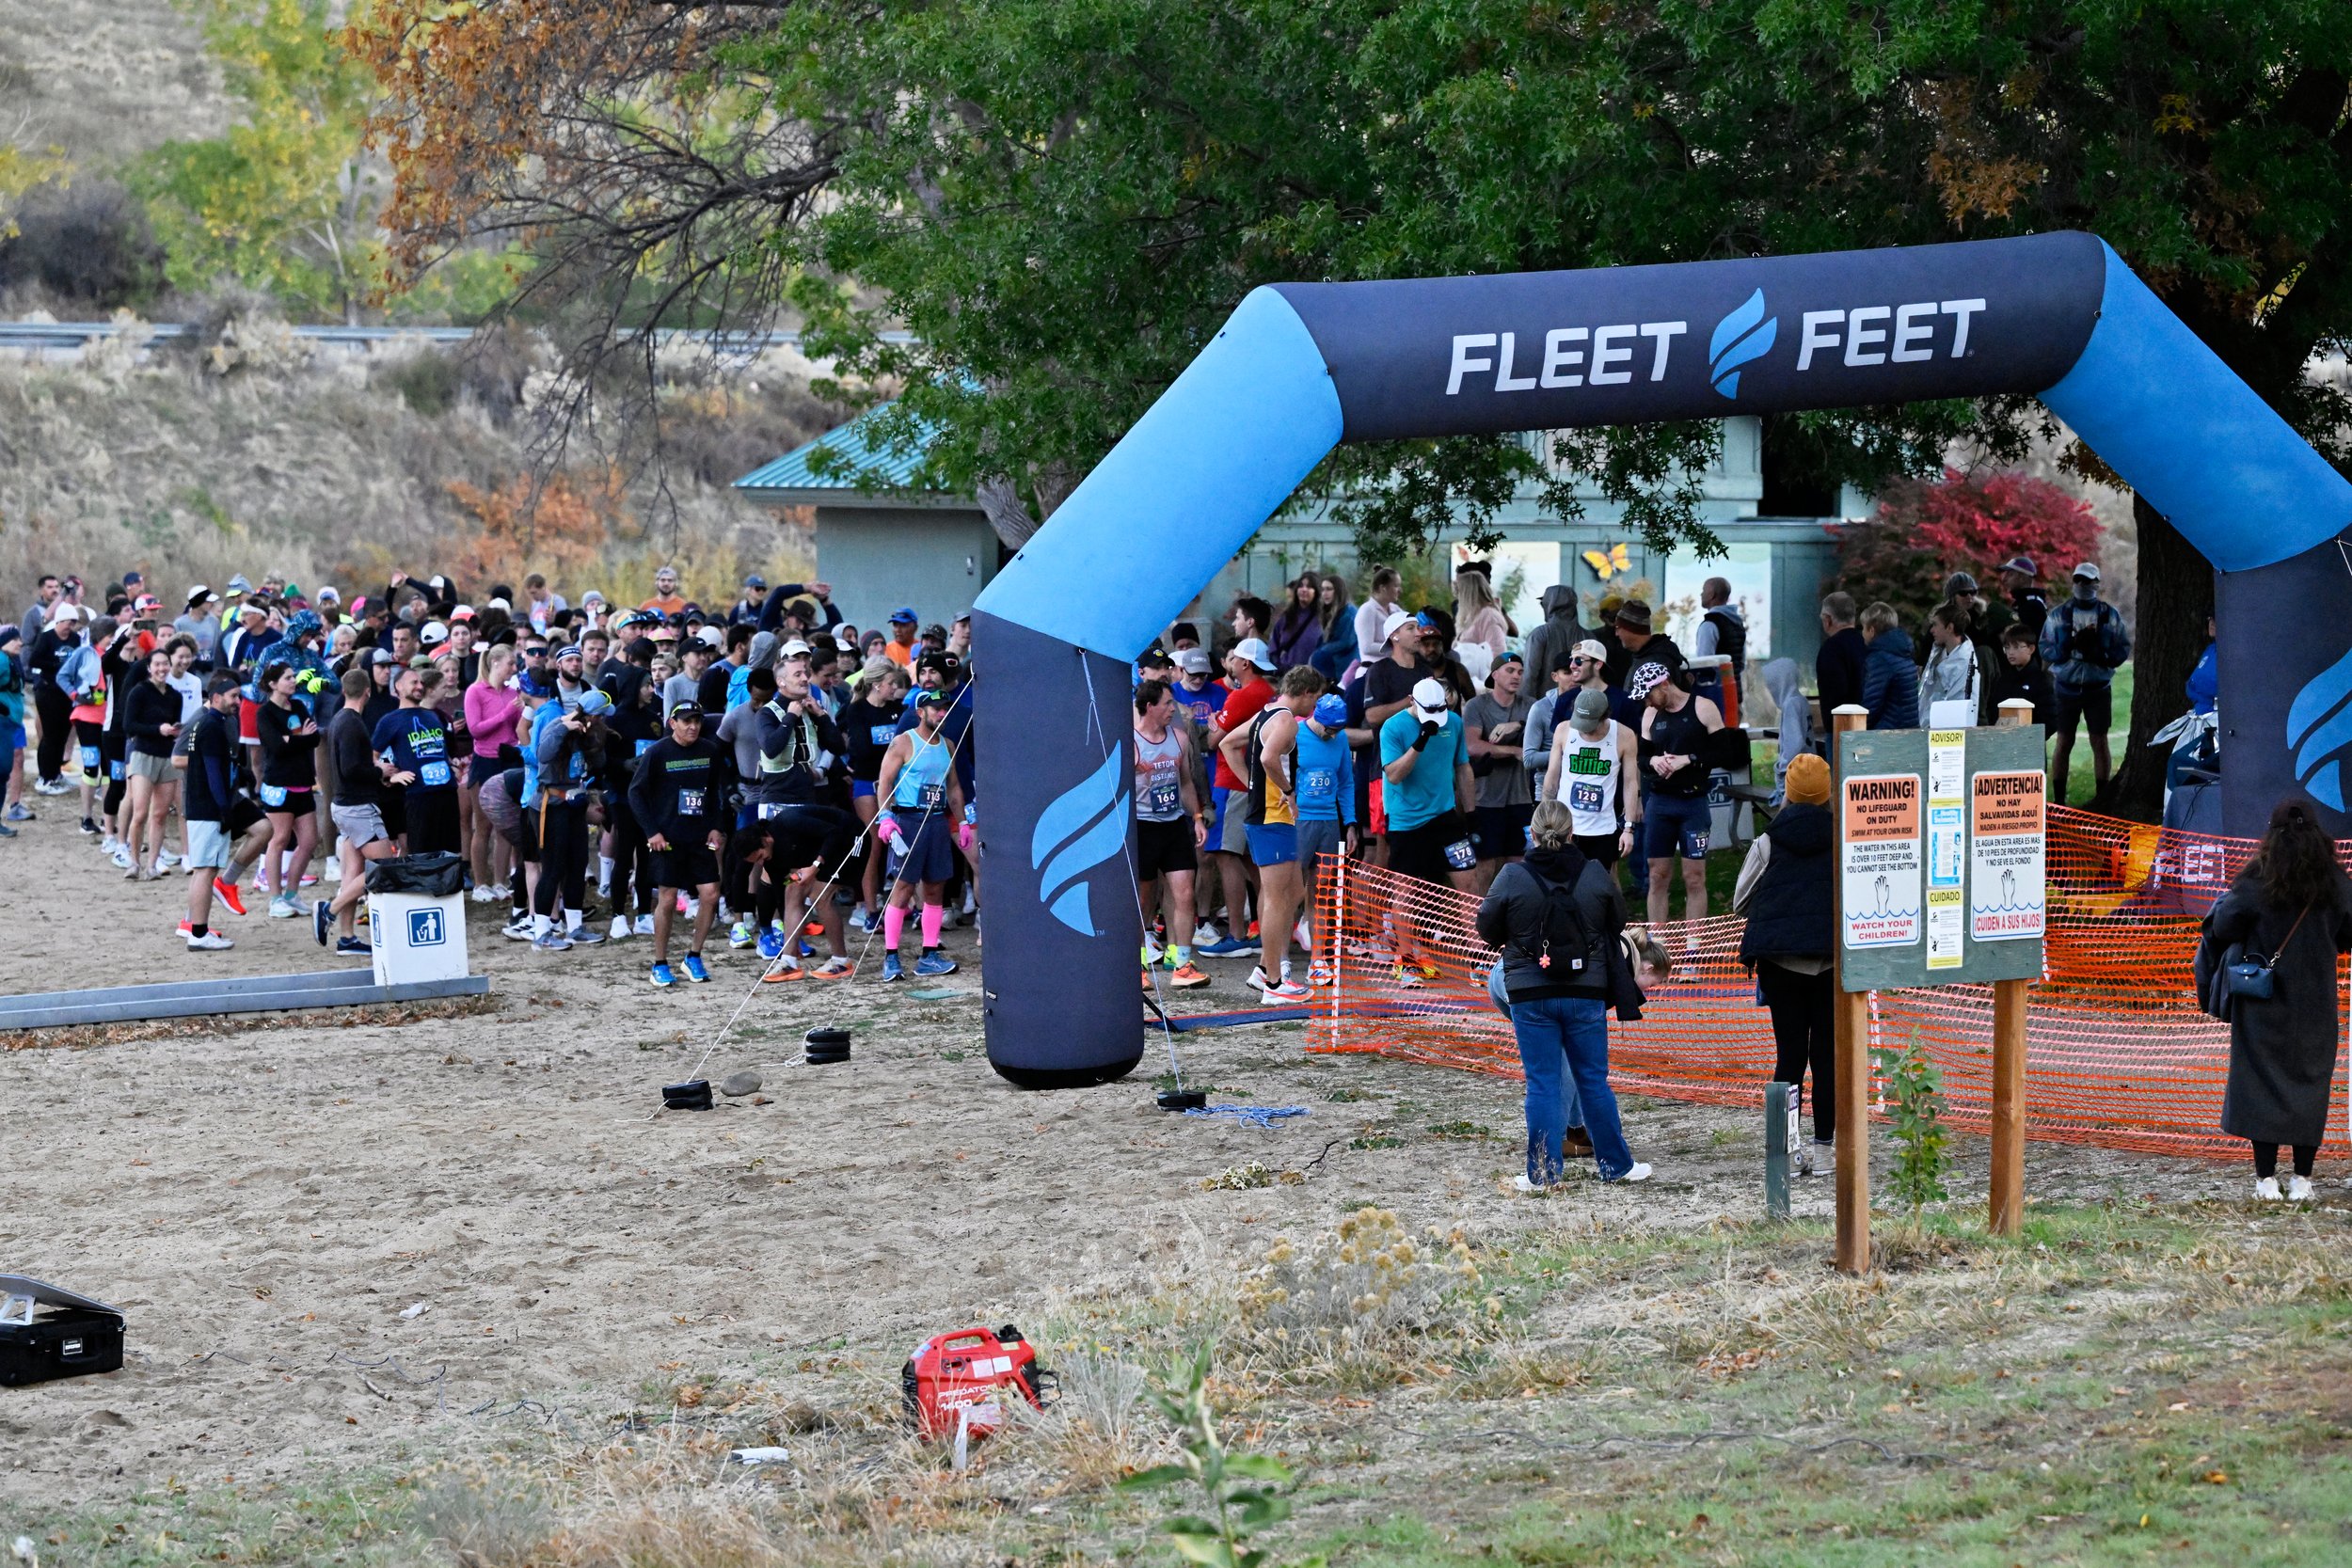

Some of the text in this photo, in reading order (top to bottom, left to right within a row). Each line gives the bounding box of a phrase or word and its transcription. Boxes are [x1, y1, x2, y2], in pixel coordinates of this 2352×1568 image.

[1445, 298, 1986, 395] FLEET FEET
[408, 728, 443, 742] IDAHO
[878, 732, 894, 741] 247
[1931, 732, 1963, 743] ADVISORY
[1581, 748, 1600, 757] BOISE
[1153, 760, 1174, 769] TETON
[1570, 755, 1611, 775] Billies
[428, 768, 446, 779] 220
[1152, 772, 1176, 781] DISTANC
[1310, 777, 1330, 786] 230
[1974, 775, 2042, 796] ¡ADVERTENCIA!
[1578, 790, 1597, 801] 128
[1850, 781, 1915, 801] WARNING!
[926, 792, 941, 801] 113
[1157, 792, 1175, 803] 166
[685, 798, 702, 806] 136
[1868, 803, 1907, 813] LIFEGUARD
[1979, 805, 2038, 820] SALVAVIDAS AQUÍ
[1879, 816, 1897, 824] DUTY
[1454, 847, 1471, 860] 178
[2008, 847, 2040, 855] PROFUNDIDAD
[1898, 863, 1917, 871] BOTTOM
[1931, 892, 1961, 902] CUIDADO
[1975, 916, 2000, 931] ¡CUIDEN
[2002, 916, 2006, 929] A
[2008, 914, 2019, 929] SUS
[2022, 913, 2042, 927] HIJOS!
[1859, 930, 1908, 940] CHILDREN!
